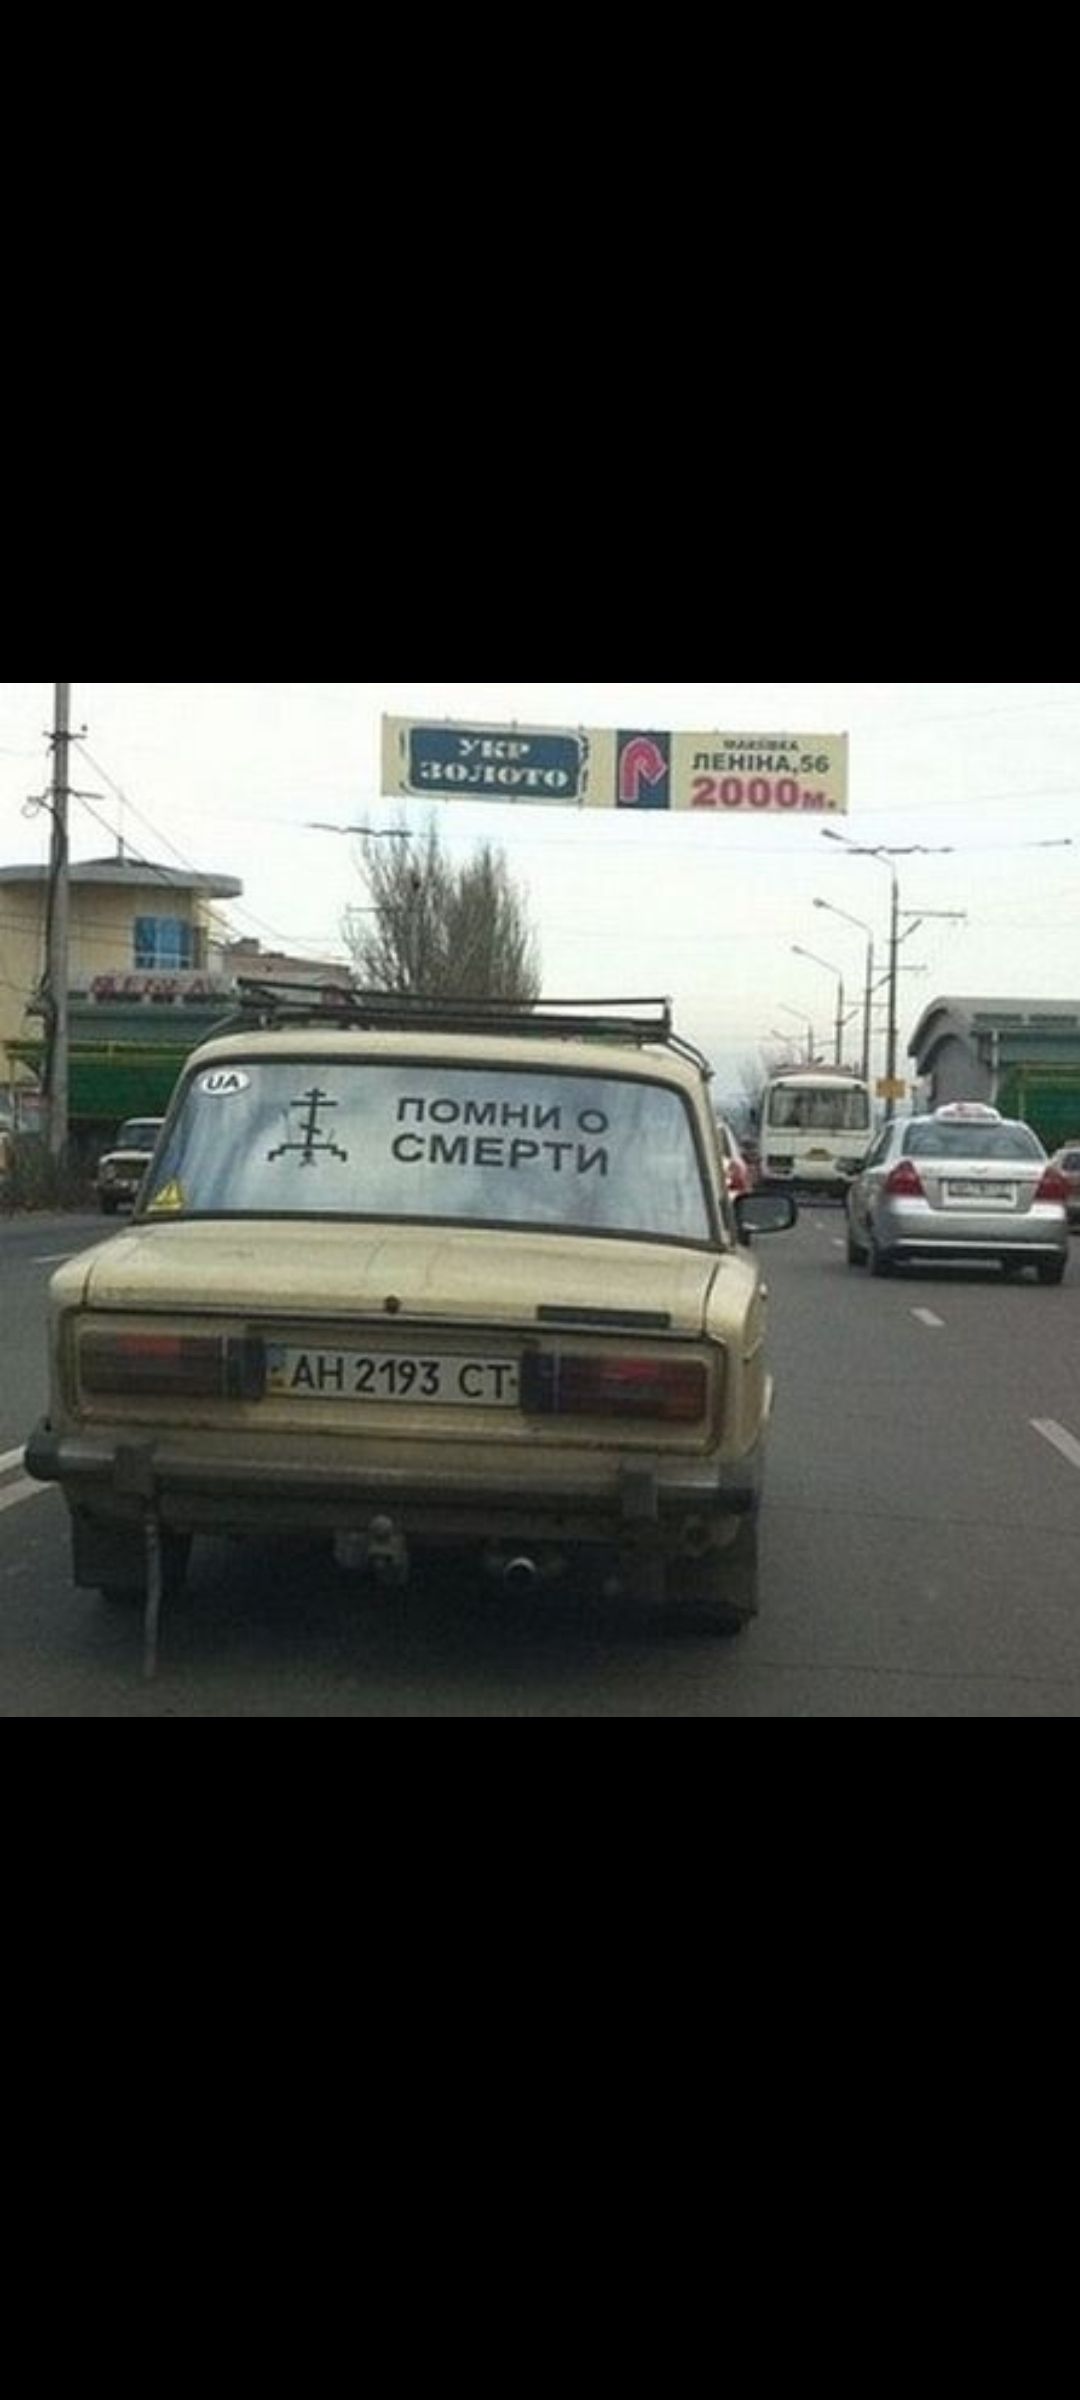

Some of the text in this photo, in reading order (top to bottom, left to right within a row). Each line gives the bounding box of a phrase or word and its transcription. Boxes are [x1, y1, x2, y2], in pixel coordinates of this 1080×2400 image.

[458, 738, 531, 760] УКР
[420, 761, 569, 788] ЗОЛОТО
[692, 752, 830, 775] ЛЕНІНА,56
[207, 1074, 241, 1092] UA
[396, 1097, 610, 1134] ПОМНИ О
[391, 1133, 609, 1177] СМЕРТИ
[290, 1354, 513, 1399] AH 2193 CT
